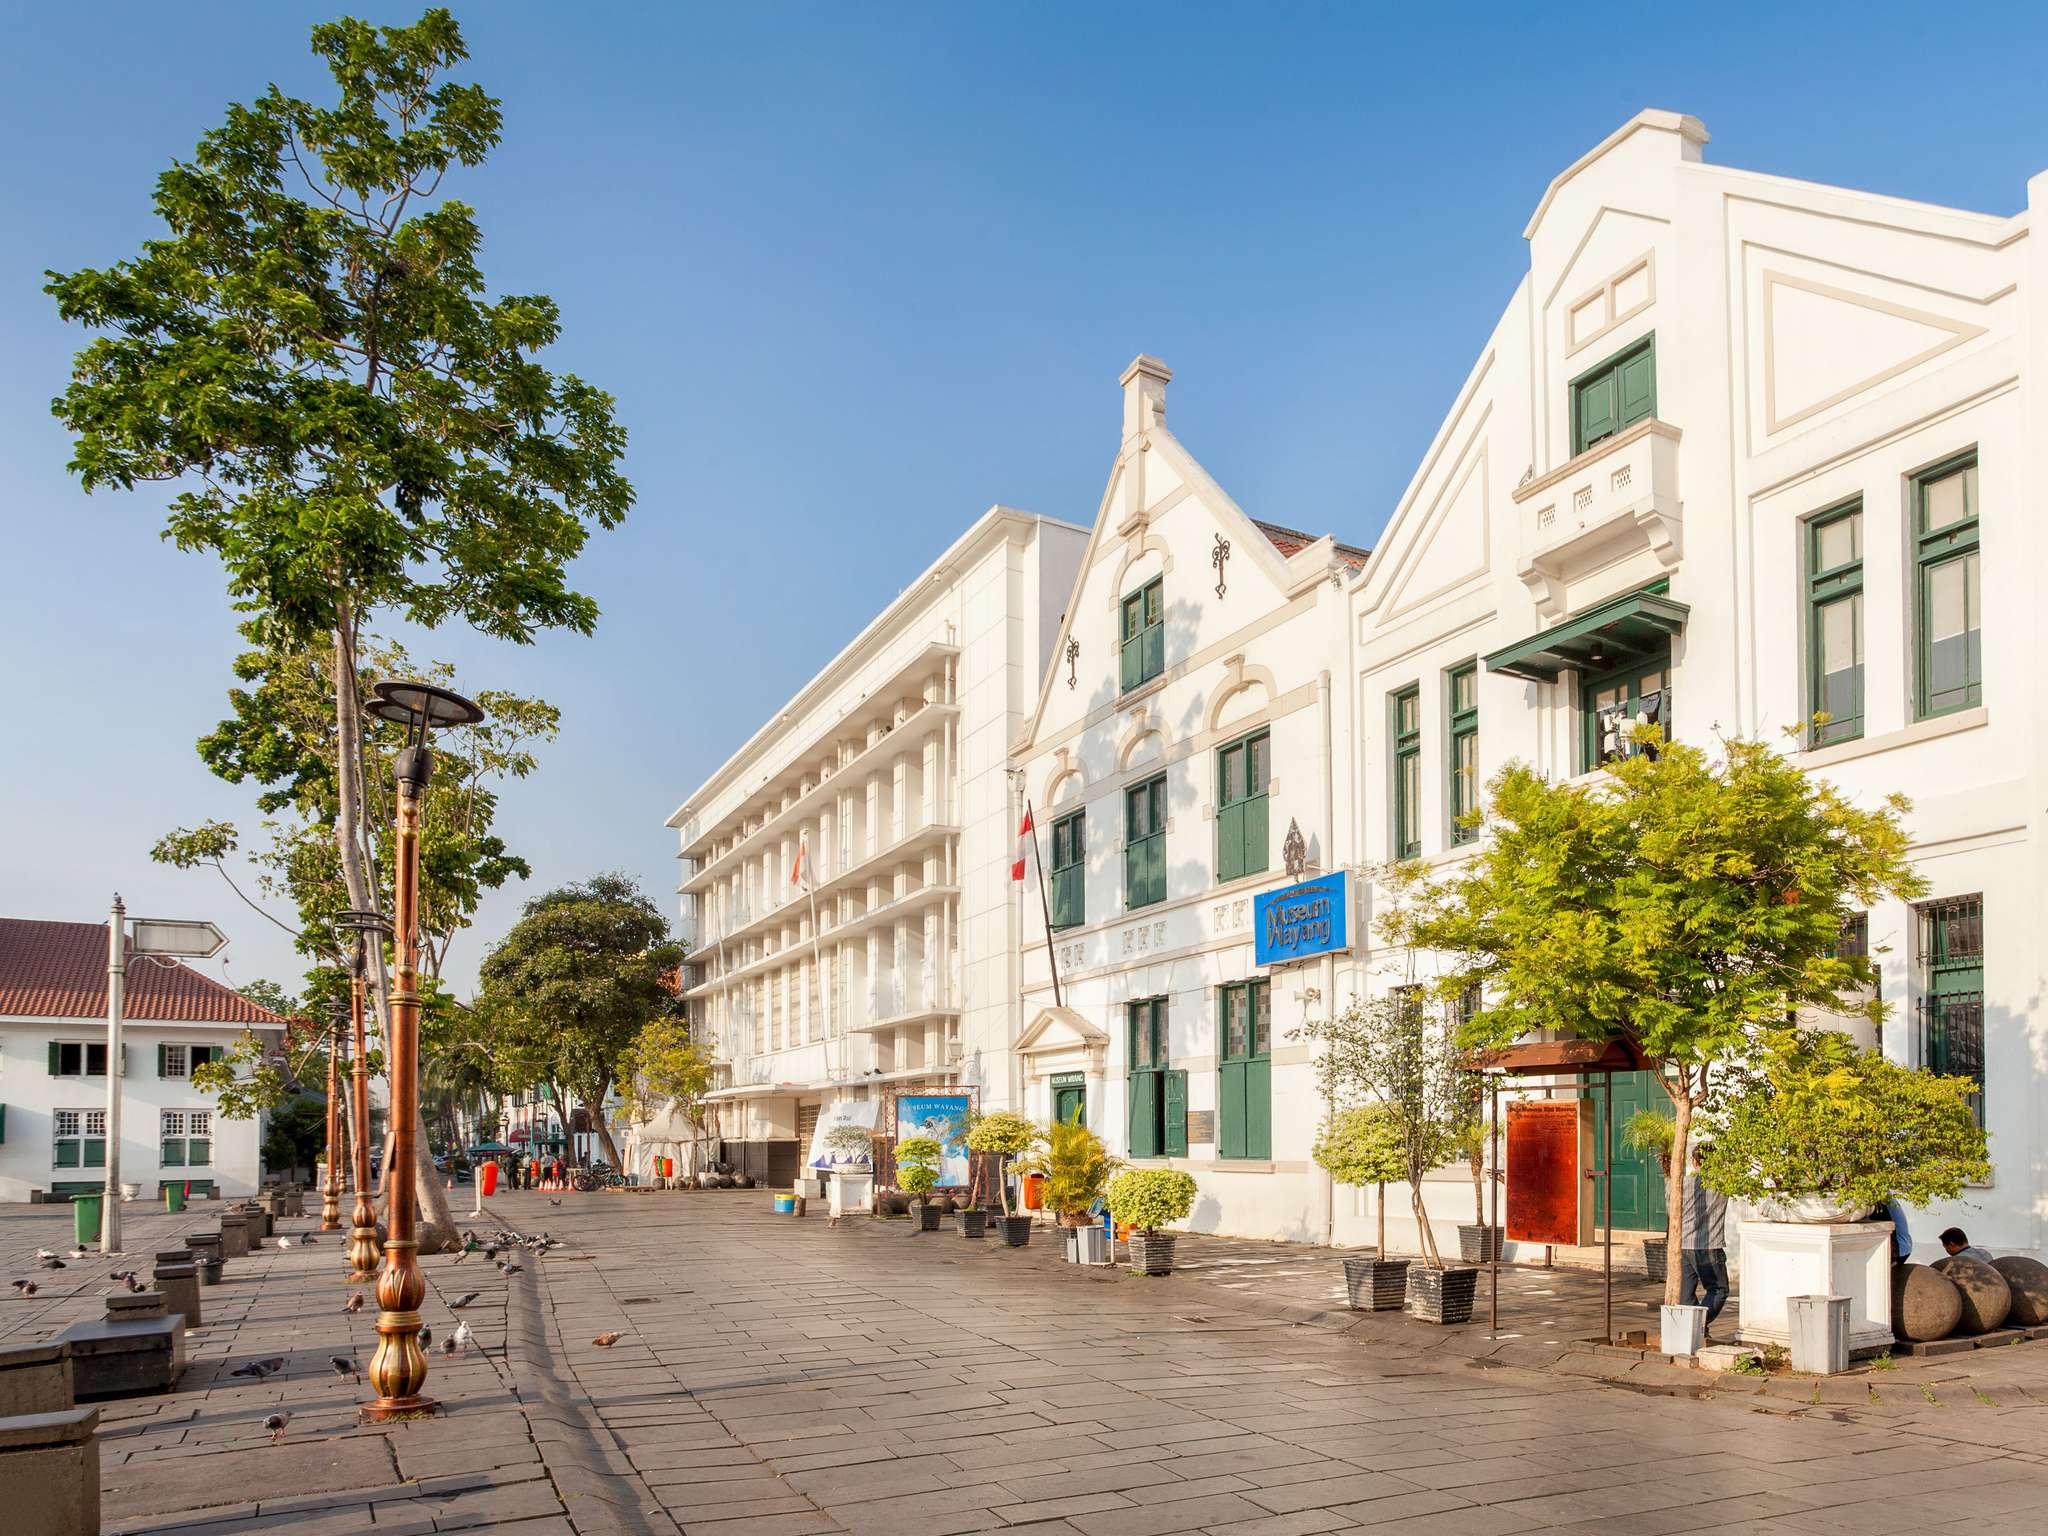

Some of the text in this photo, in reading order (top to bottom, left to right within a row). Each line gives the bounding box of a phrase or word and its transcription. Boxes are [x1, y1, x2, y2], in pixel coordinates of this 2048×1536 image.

[1267, 898, 1329, 928] Museum
[1267, 919, 1330, 950] Wayang
[934, 1103, 964, 1112] WAYANG
